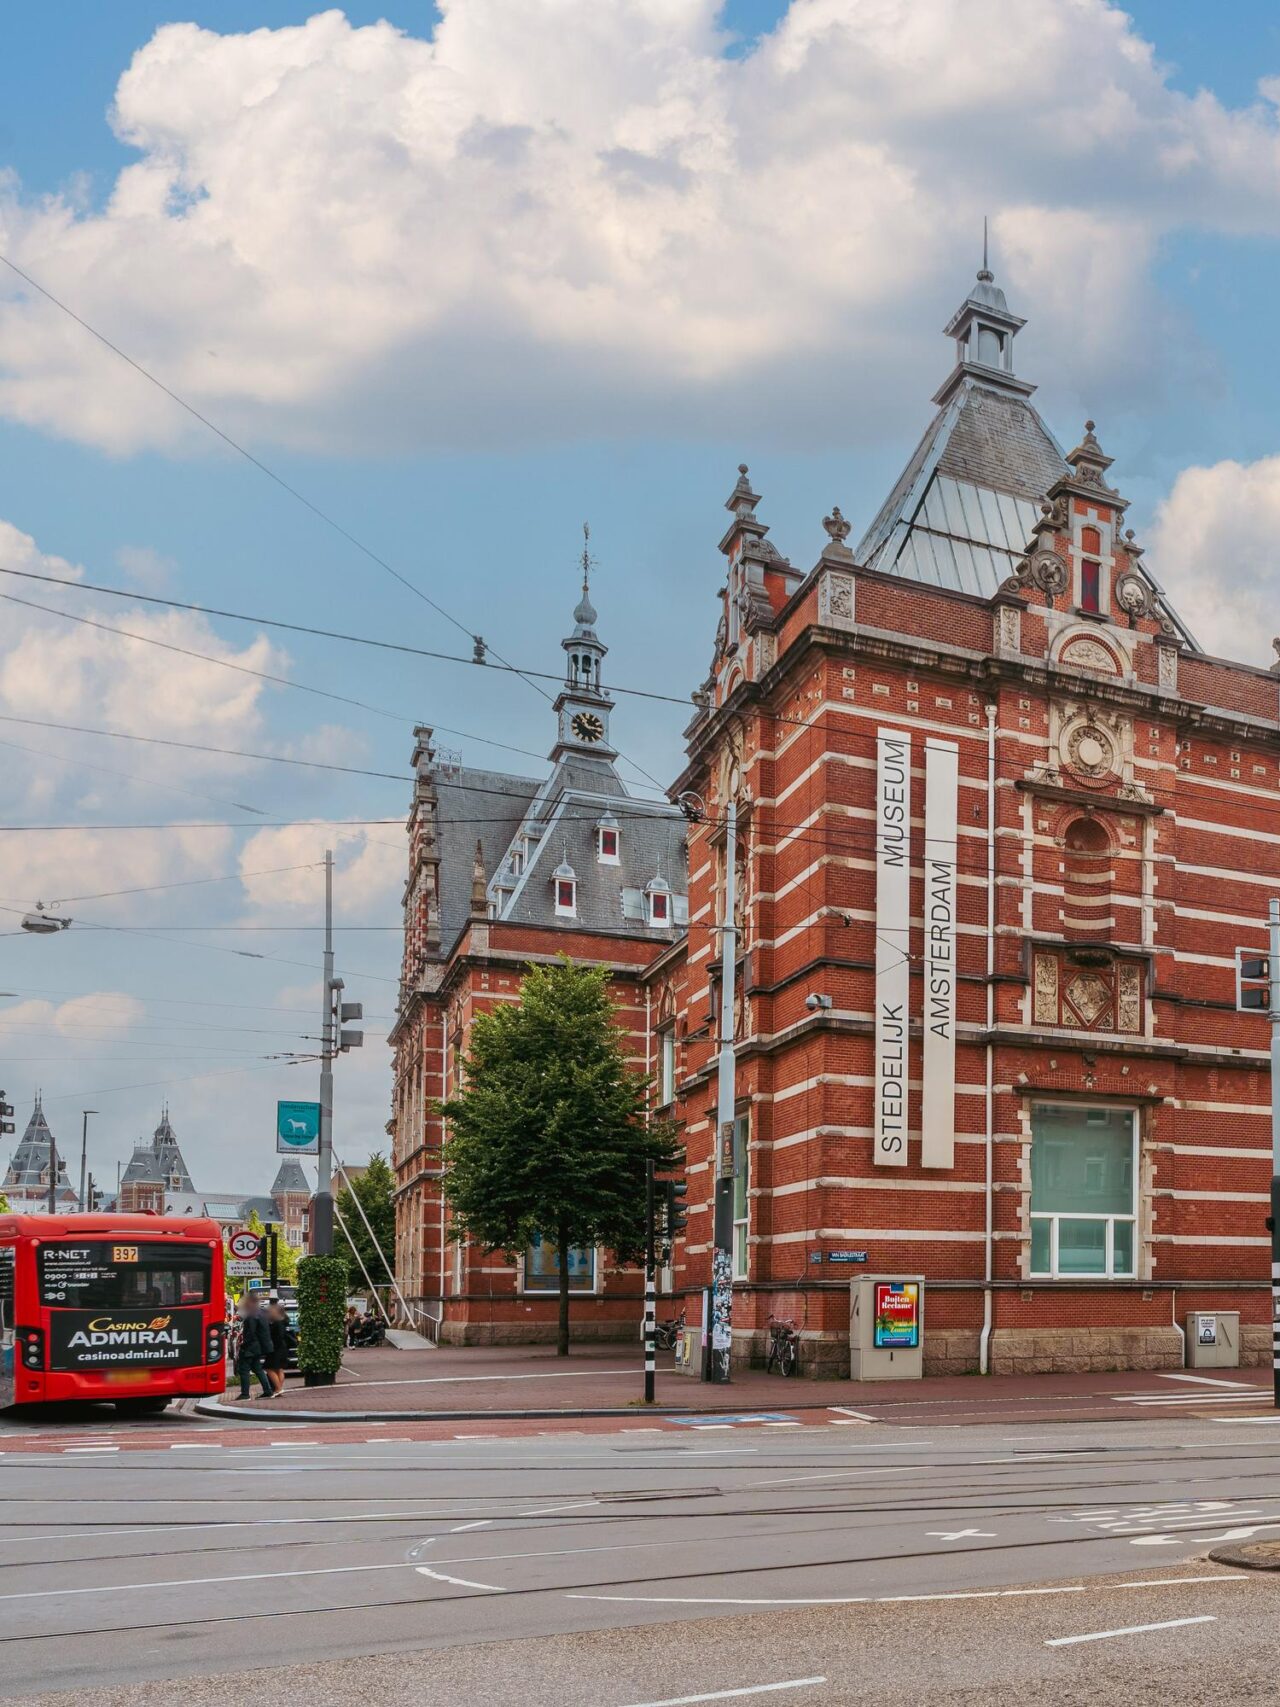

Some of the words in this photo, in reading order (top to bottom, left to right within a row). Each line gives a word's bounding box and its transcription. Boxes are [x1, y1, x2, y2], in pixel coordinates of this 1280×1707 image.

[884, 741, 905, 867] MUSEUM
[930, 862, 952, 1040] AMSTERDAM
[881, 1003, 903, 1153] STEDELIJK
[235, 1240, 257, 1251] 30
[115, 1248, 137, 1260] 397
[884, 1295, 910, 1303] Buiten
[88, 1317, 147, 1331] CASINO
[67, 1329, 188, 1348] ADMIRAL
[77, 1349, 179, 1361] casinoadmiral.nl
